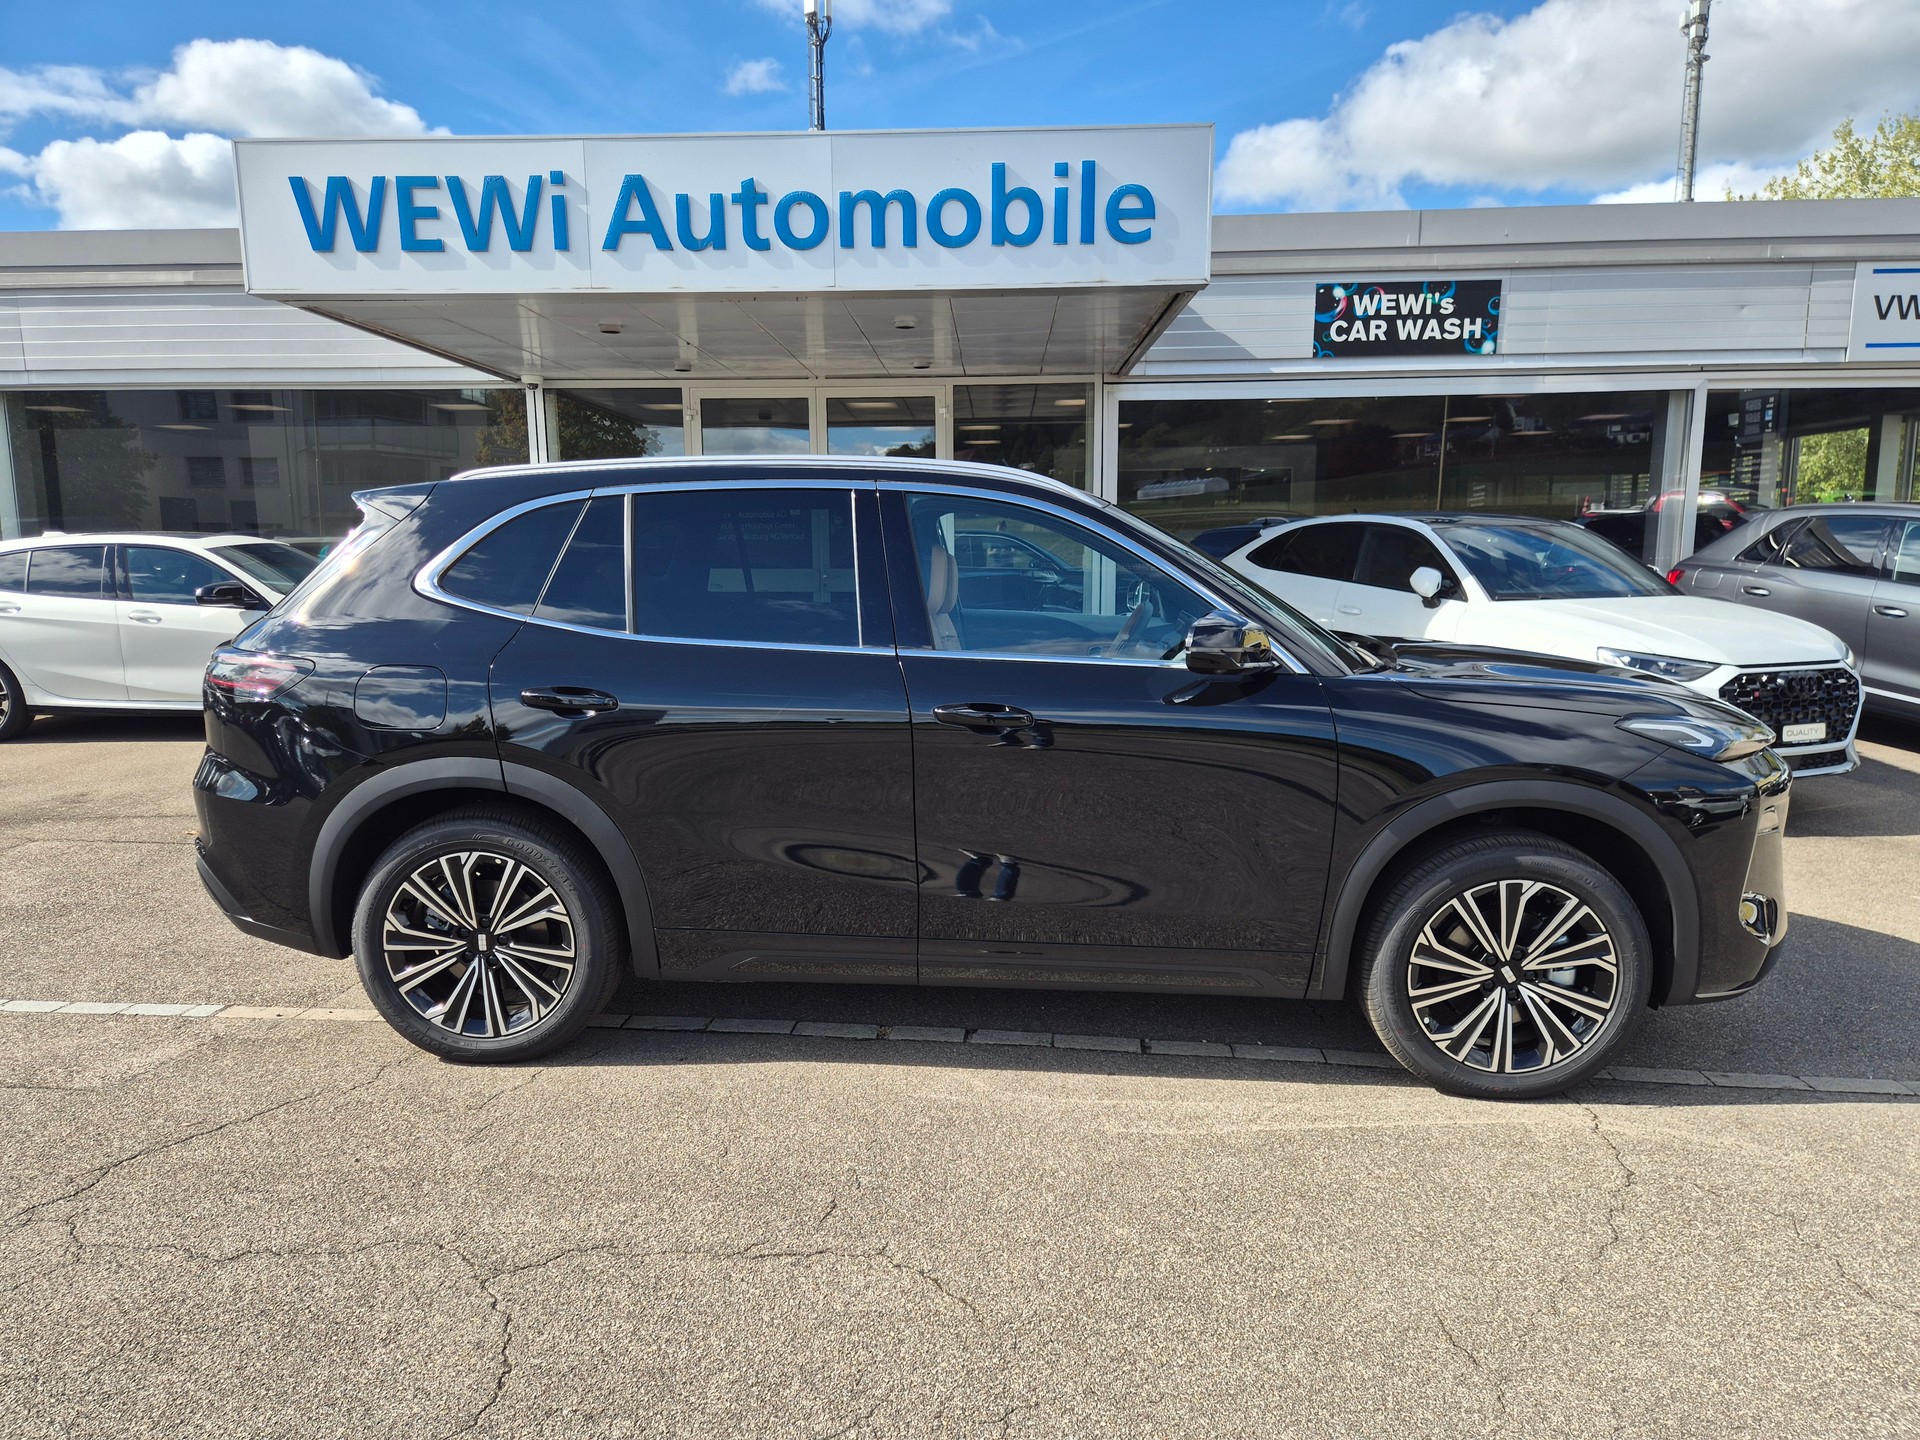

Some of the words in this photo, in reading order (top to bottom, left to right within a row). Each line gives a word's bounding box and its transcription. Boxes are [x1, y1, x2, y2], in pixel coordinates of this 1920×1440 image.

[288, 170, 569, 252] WEWi
[602, 160, 1156, 251] Automobile
[1353, 292, 1454, 316] WEWi's
[1330, 319, 1388, 342] CAR
[1396, 317, 1482, 341] WASH
[1786, 728, 1819, 737] QUALITY
[503, 837, 577, 893] GOODYEAR
